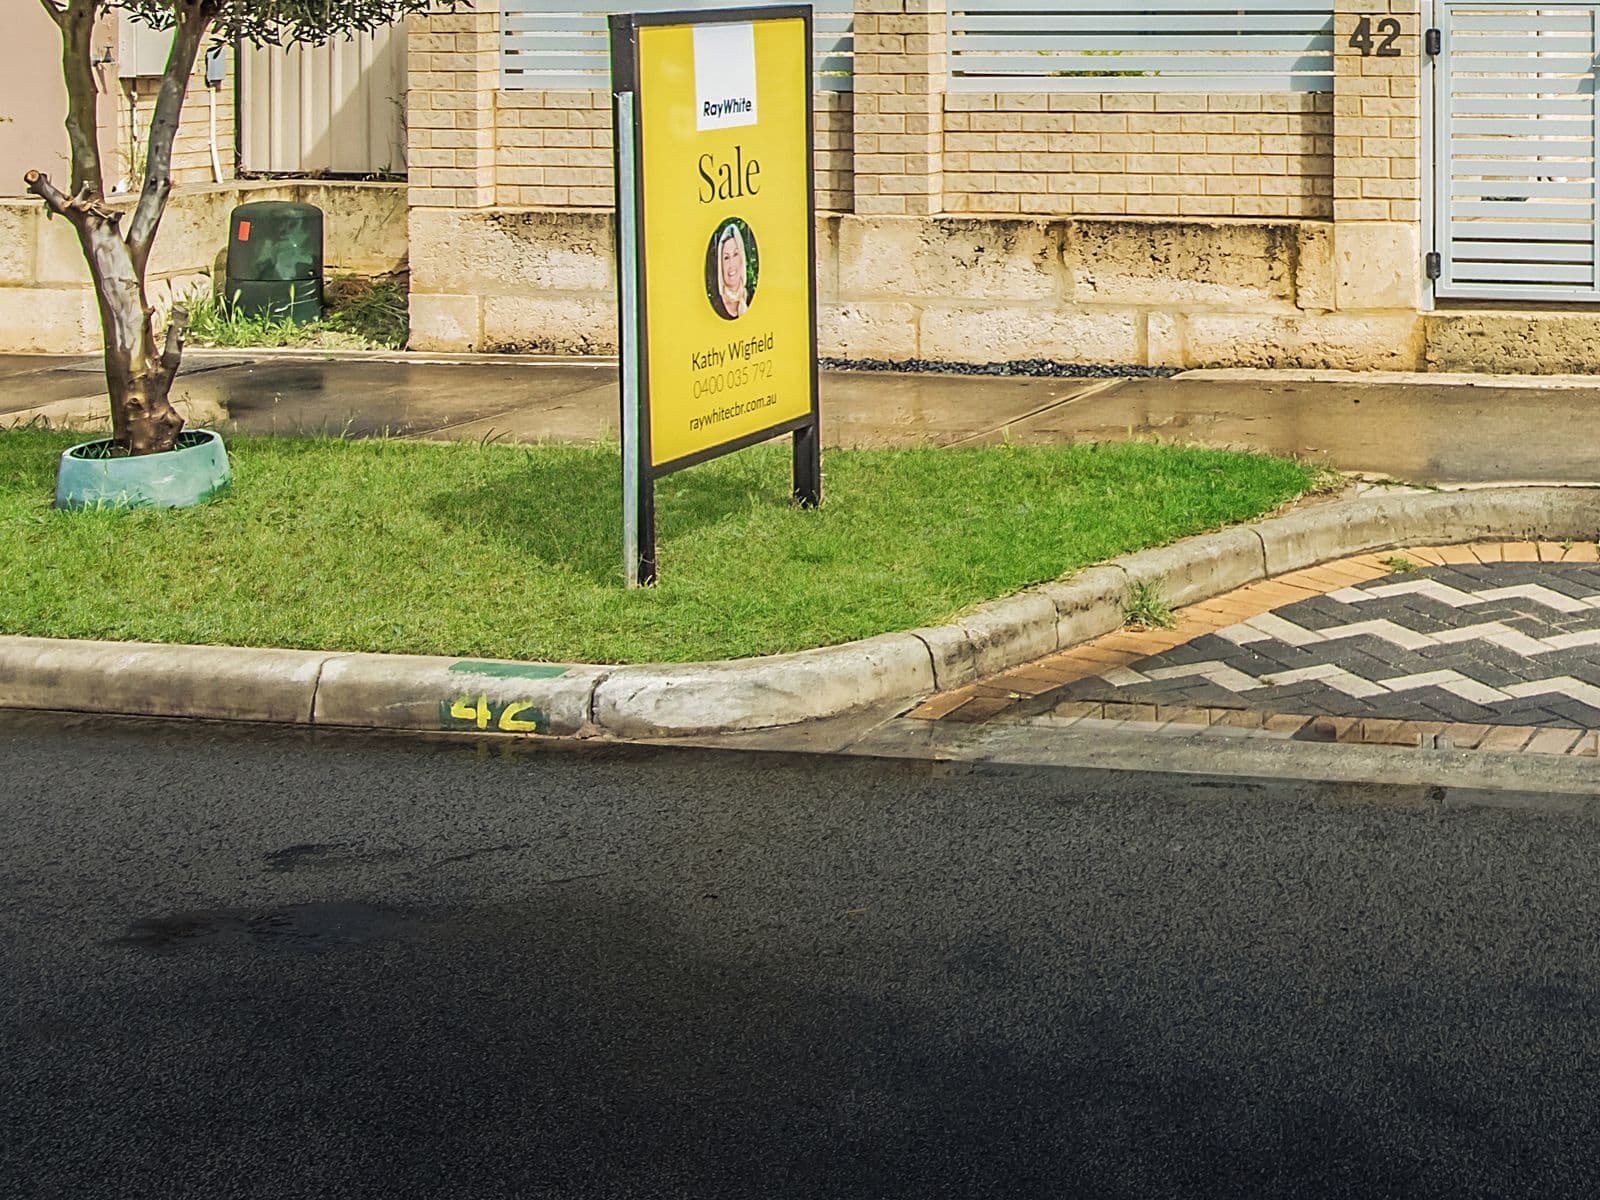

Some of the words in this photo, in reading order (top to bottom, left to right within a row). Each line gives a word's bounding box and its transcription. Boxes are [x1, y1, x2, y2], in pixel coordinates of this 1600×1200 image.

[1349, 17, 1402, 57] 42
[698, 146, 760, 204] Sale
[691, 347, 726, 372] Kathy
[727, 332, 774, 361] Wigfield
[693, 373, 724, 400] 0400
[726, 366, 749, 389] 035
[751, 359, 773, 382] 792
[689, 393, 777, 432] raywhitecbr.com.au
[450, 694, 537, 732] 42
